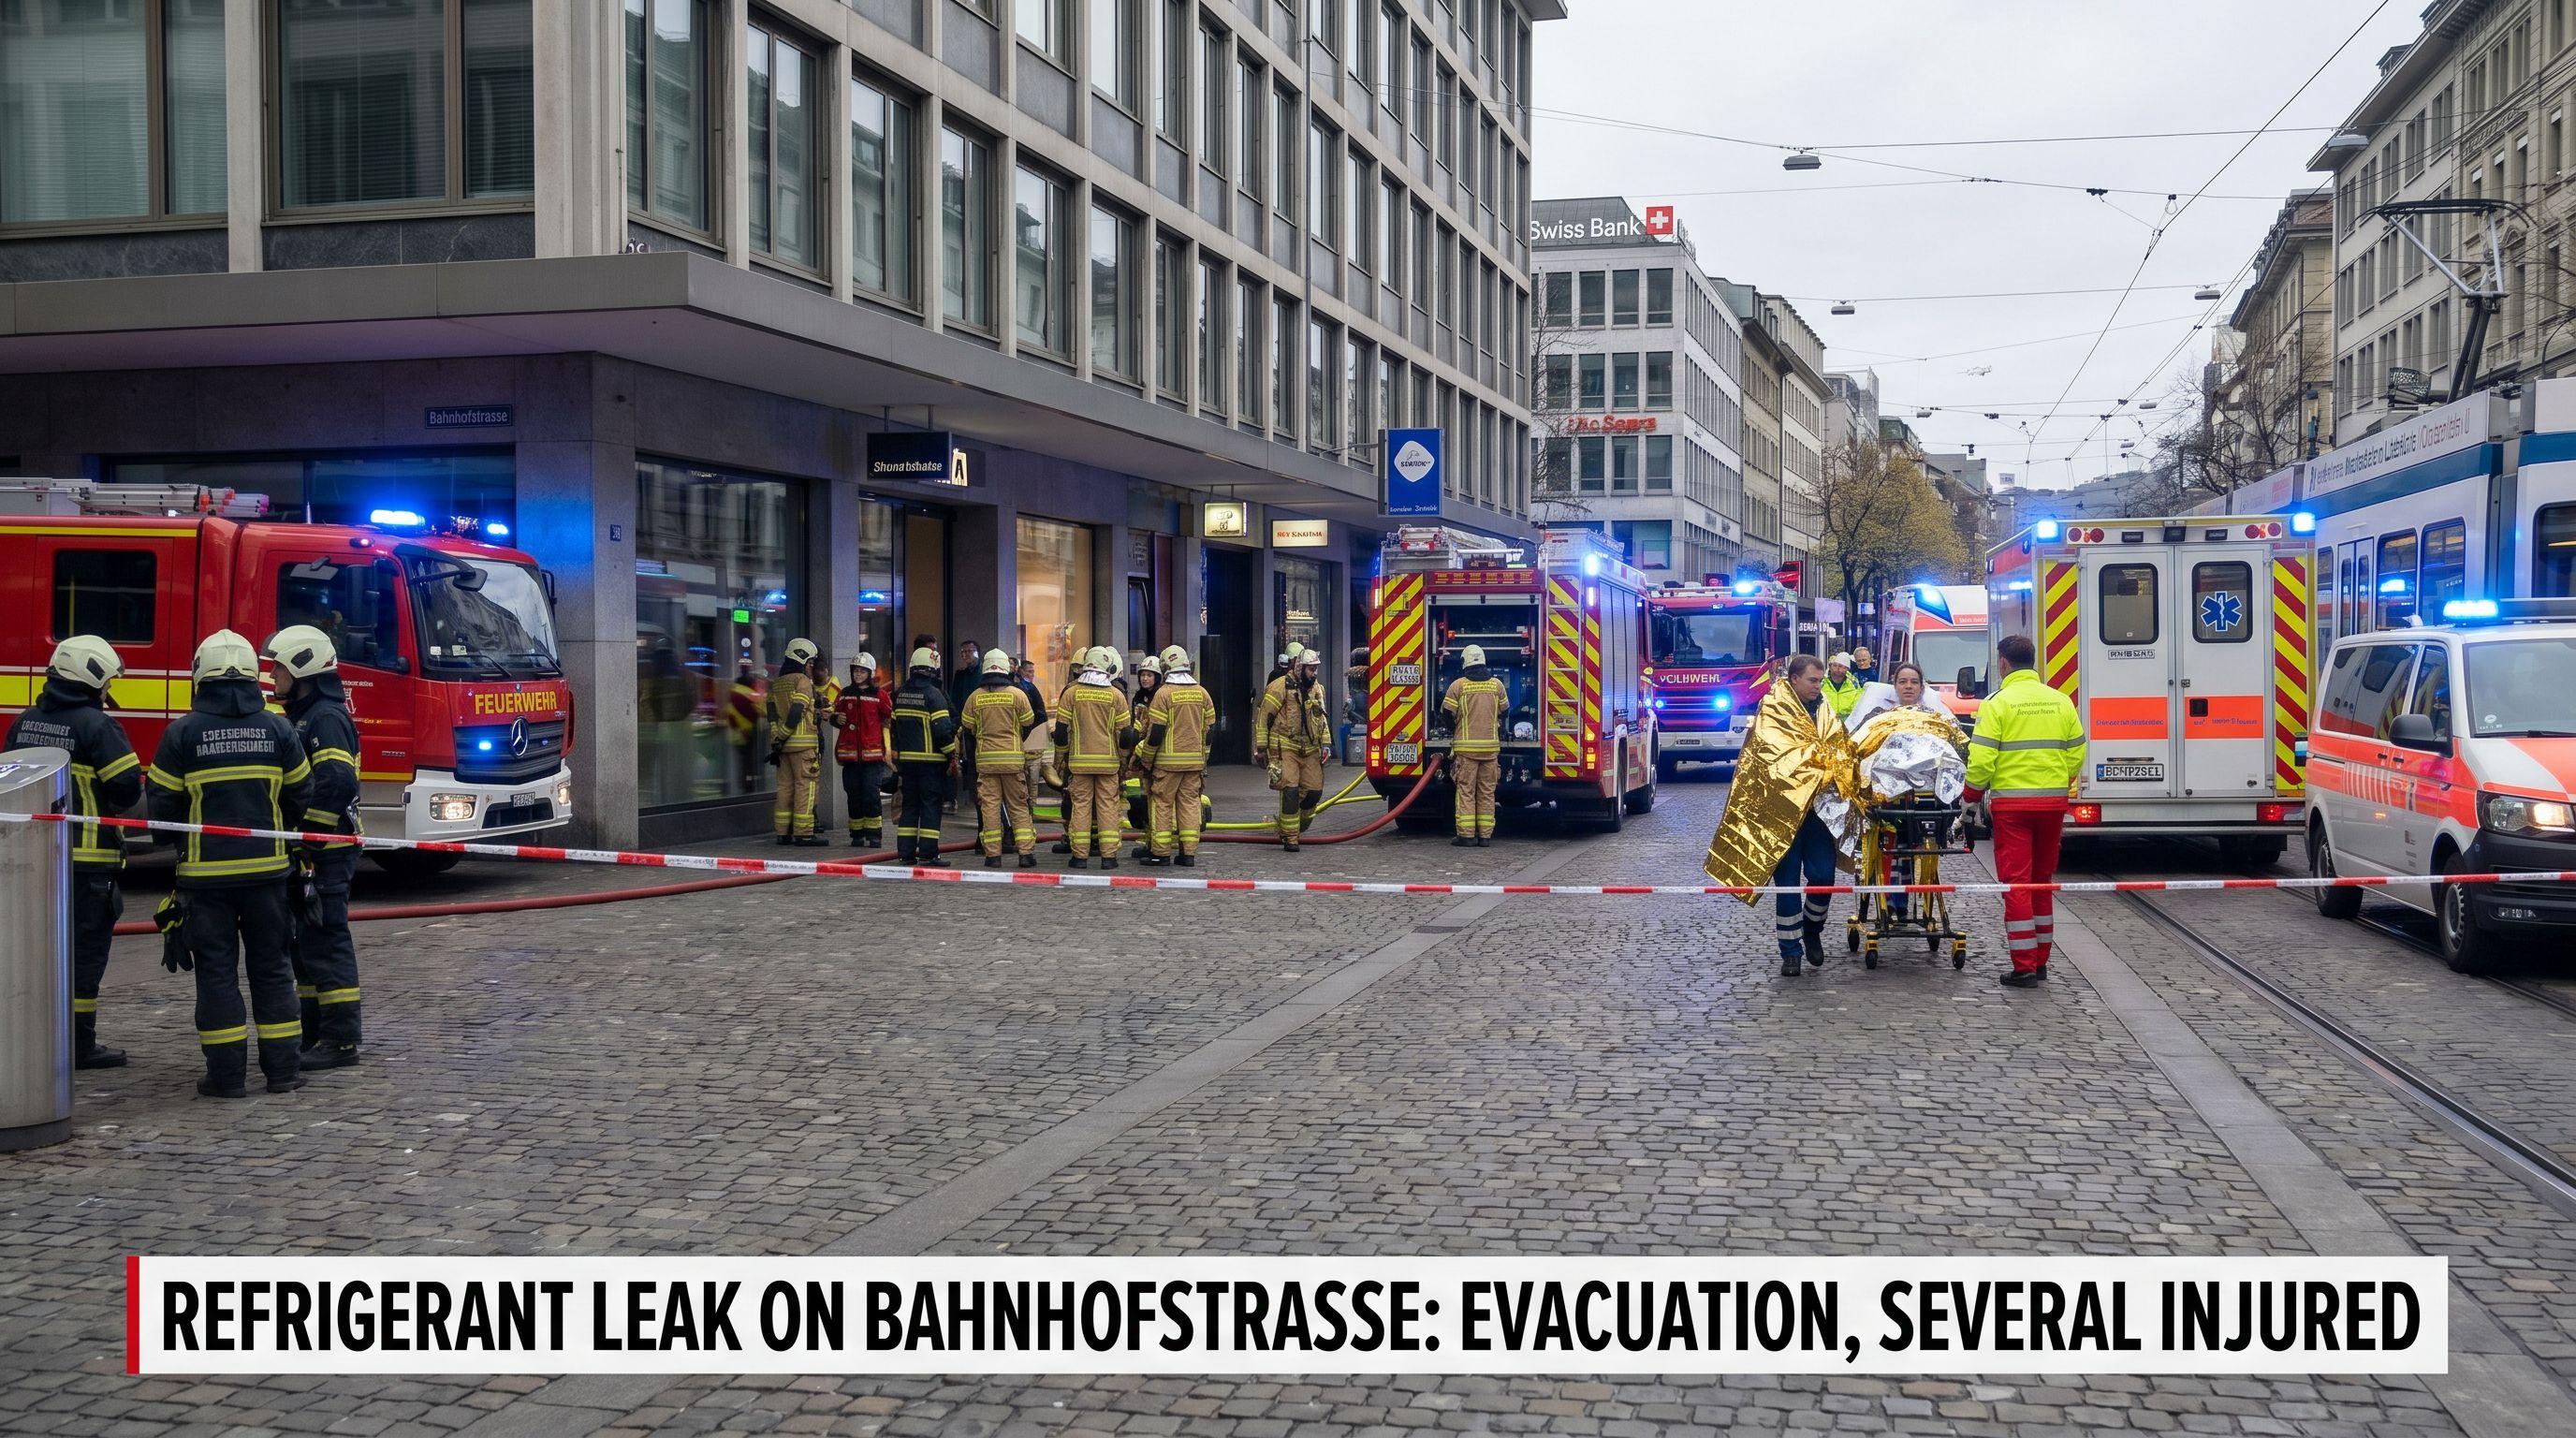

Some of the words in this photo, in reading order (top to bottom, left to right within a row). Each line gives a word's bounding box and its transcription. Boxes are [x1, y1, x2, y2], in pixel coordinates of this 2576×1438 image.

[1530, 219, 1585, 240] Swiss
[1590, 215, 1641, 238] Bank
[430, 410, 508, 424] Bahnhofstrasse
[475, 691, 558, 714] FEUERWEHR
